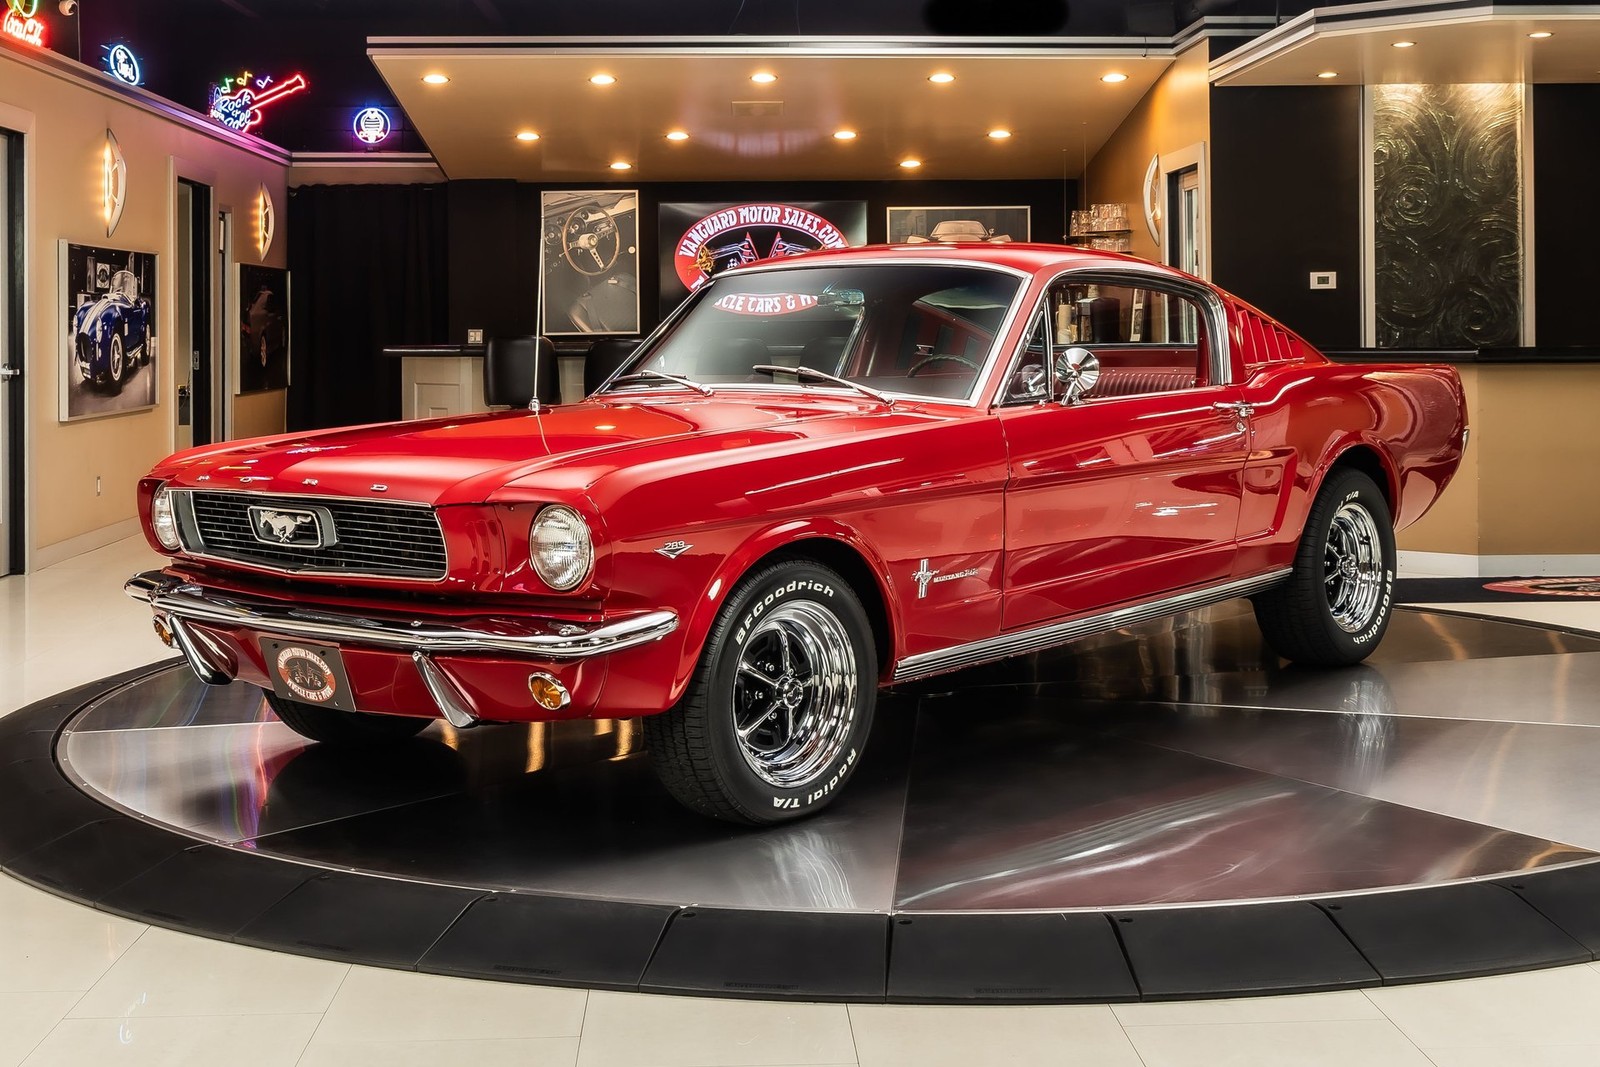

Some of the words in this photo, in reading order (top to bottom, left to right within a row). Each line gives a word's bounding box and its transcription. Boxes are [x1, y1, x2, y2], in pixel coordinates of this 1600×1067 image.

[219, 91, 251, 113] Rock
[679, 209, 737, 258] VANGUARD
[738, 206, 781, 224] MOTOR
[747, 296, 781, 313] CARS
[785, 294, 796, 310] &
[664, 540, 685, 550] 289
[735, 580, 834, 645] BFGoodrich
[1353, 569, 1393, 645] BFGoodrich
[807, 748, 857, 805] Radial
[773, 796, 800, 809] T/A
